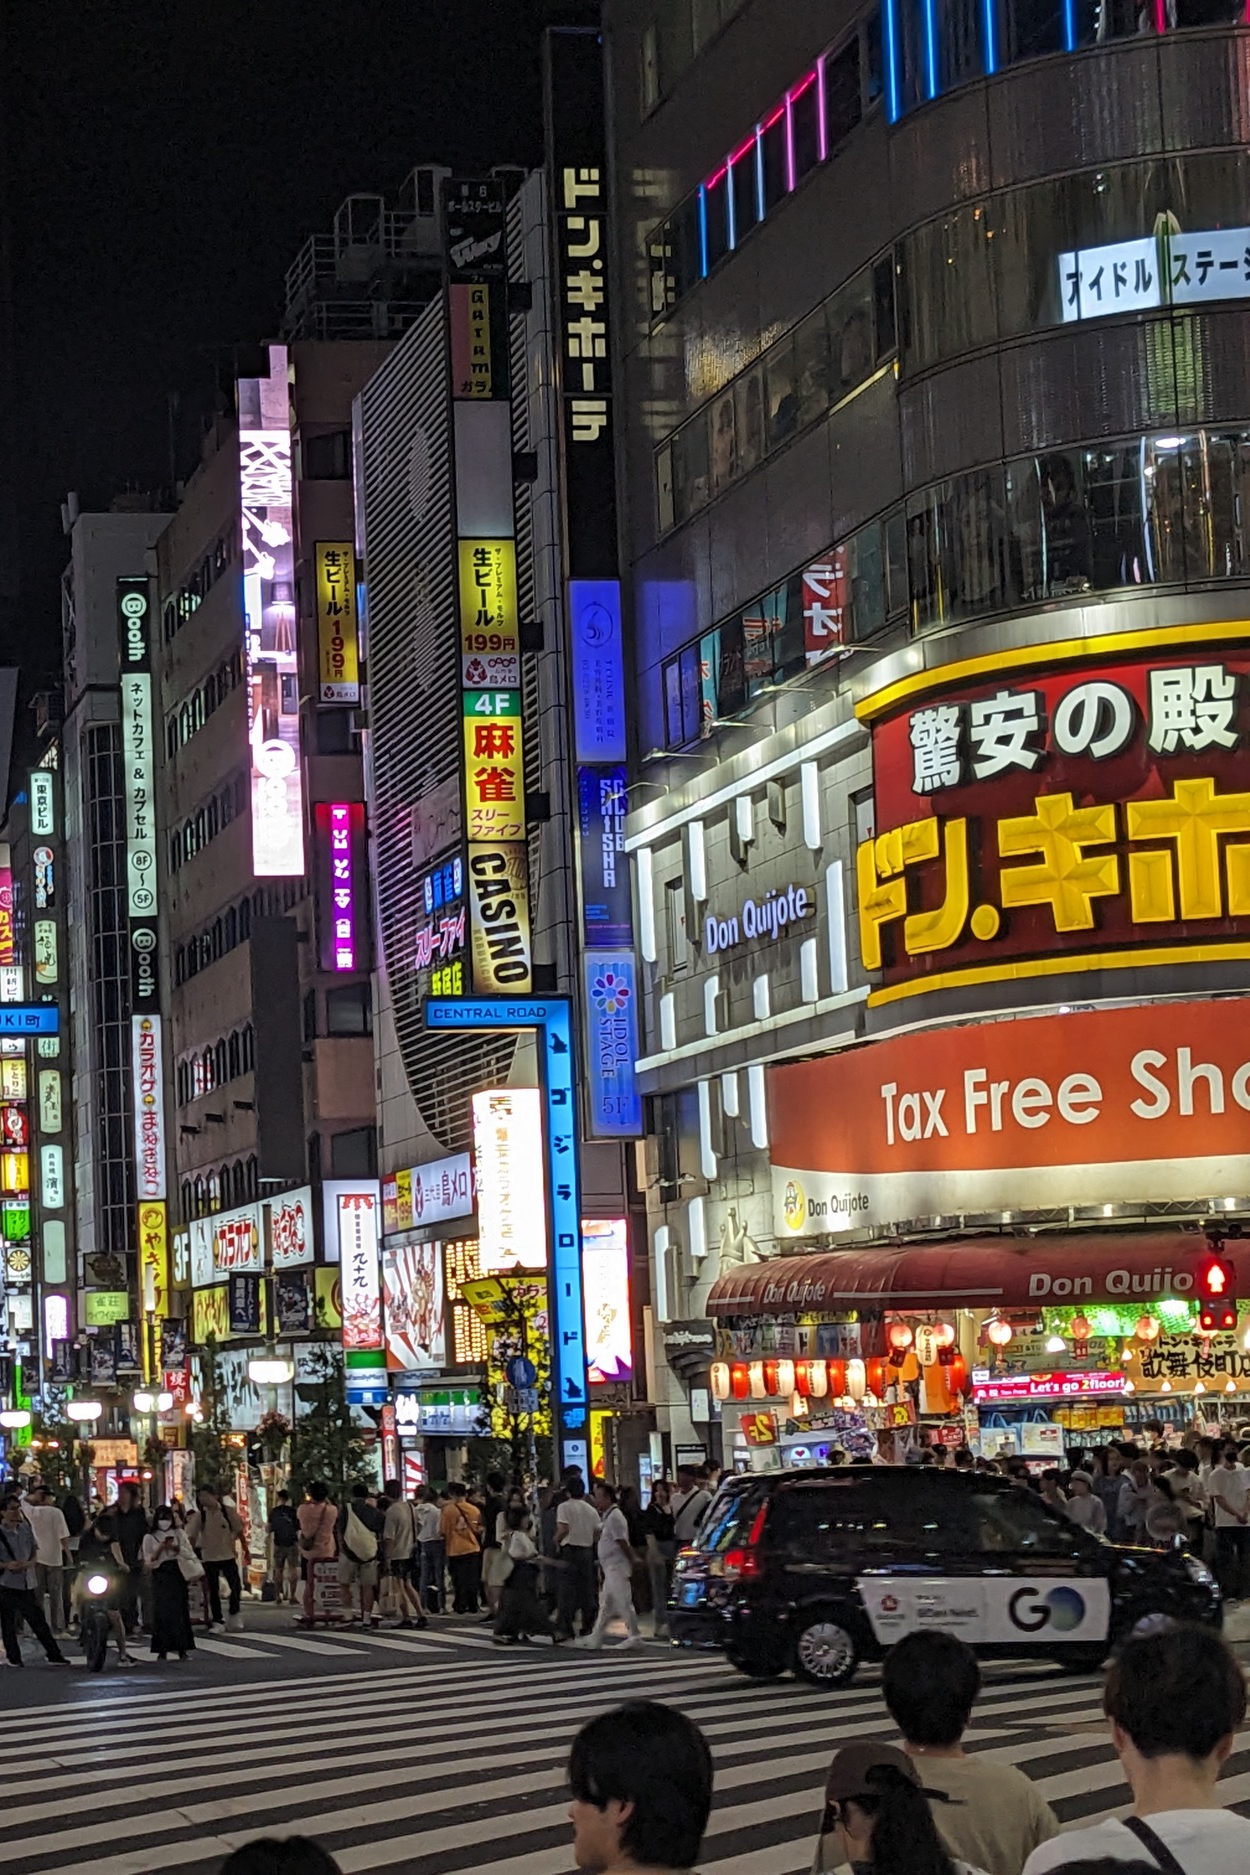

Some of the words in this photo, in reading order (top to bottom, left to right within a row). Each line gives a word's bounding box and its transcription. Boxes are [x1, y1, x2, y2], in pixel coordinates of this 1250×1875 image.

[325, 551, 342, 616] 生ビール
[473, 548, 494, 627] 生ビール
[465, 634, 515, 651] 199円
[474, 694, 510, 715] 4F
[910, 664, 1239, 794] 驚安の殿
[473, 723, 516, 802] 麻雀
[471, 853, 529, 984] CASINO
[706, 916, 738, 954] Don
[743, 883, 807, 940] Quijote
[434, 1008, 502, 1019] CENTRAL
[507, 1007, 546, 1018] ROAD
[599, 1018, 616, 1078] STAGE
[613, 1018, 629, 1067] IDOL
[881, 1081, 949, 1145] Tax
[963, 1068, 1103, 1133] Free
[808, 1198, 827, 1217] Don
[831, 1191, 869, 1218] Quijote
[174, 1232, 189, 1283] 3F
[352, 1253, 368, 1288] 九十九
[763, 1284, 784, 1304] Don
[1029, 1272, 1093, 1297] Don
[1062, 1383, 1079, 1396] go
